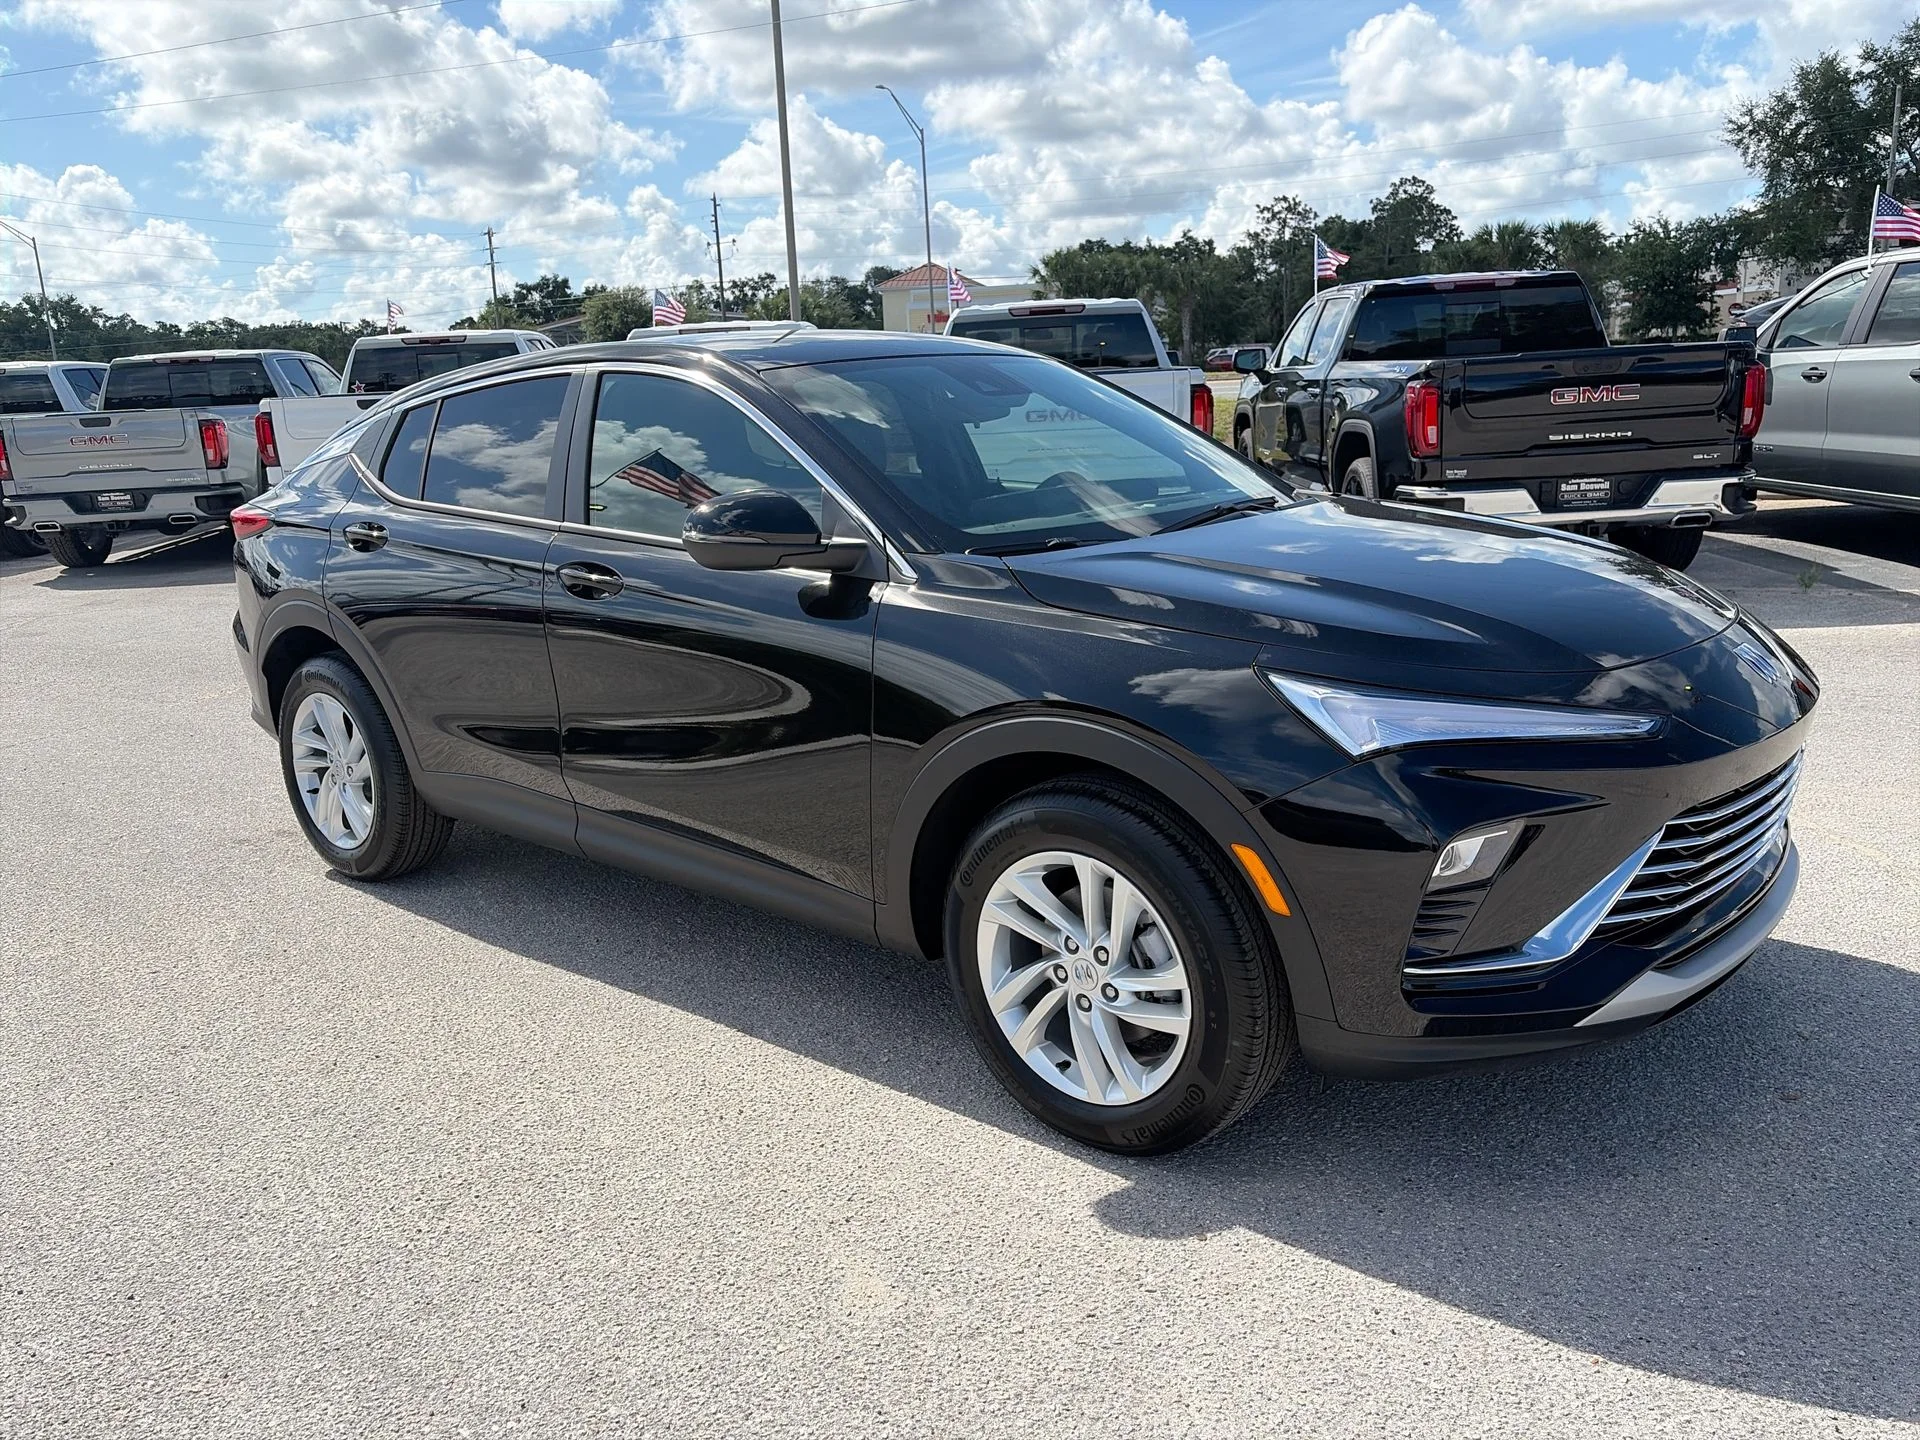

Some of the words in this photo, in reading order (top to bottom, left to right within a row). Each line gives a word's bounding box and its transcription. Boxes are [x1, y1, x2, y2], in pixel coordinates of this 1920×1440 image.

[1550, 383, 1641, 405] GMC
[69, 433, 129, 446] GMC
[1549, 431, 1632, 441] SIERRA
[1580, 482, 1609, 490] Boswell
[960, 821, 1018, 886] Continental
[1134, 1083, 1206, 1143] Continental
